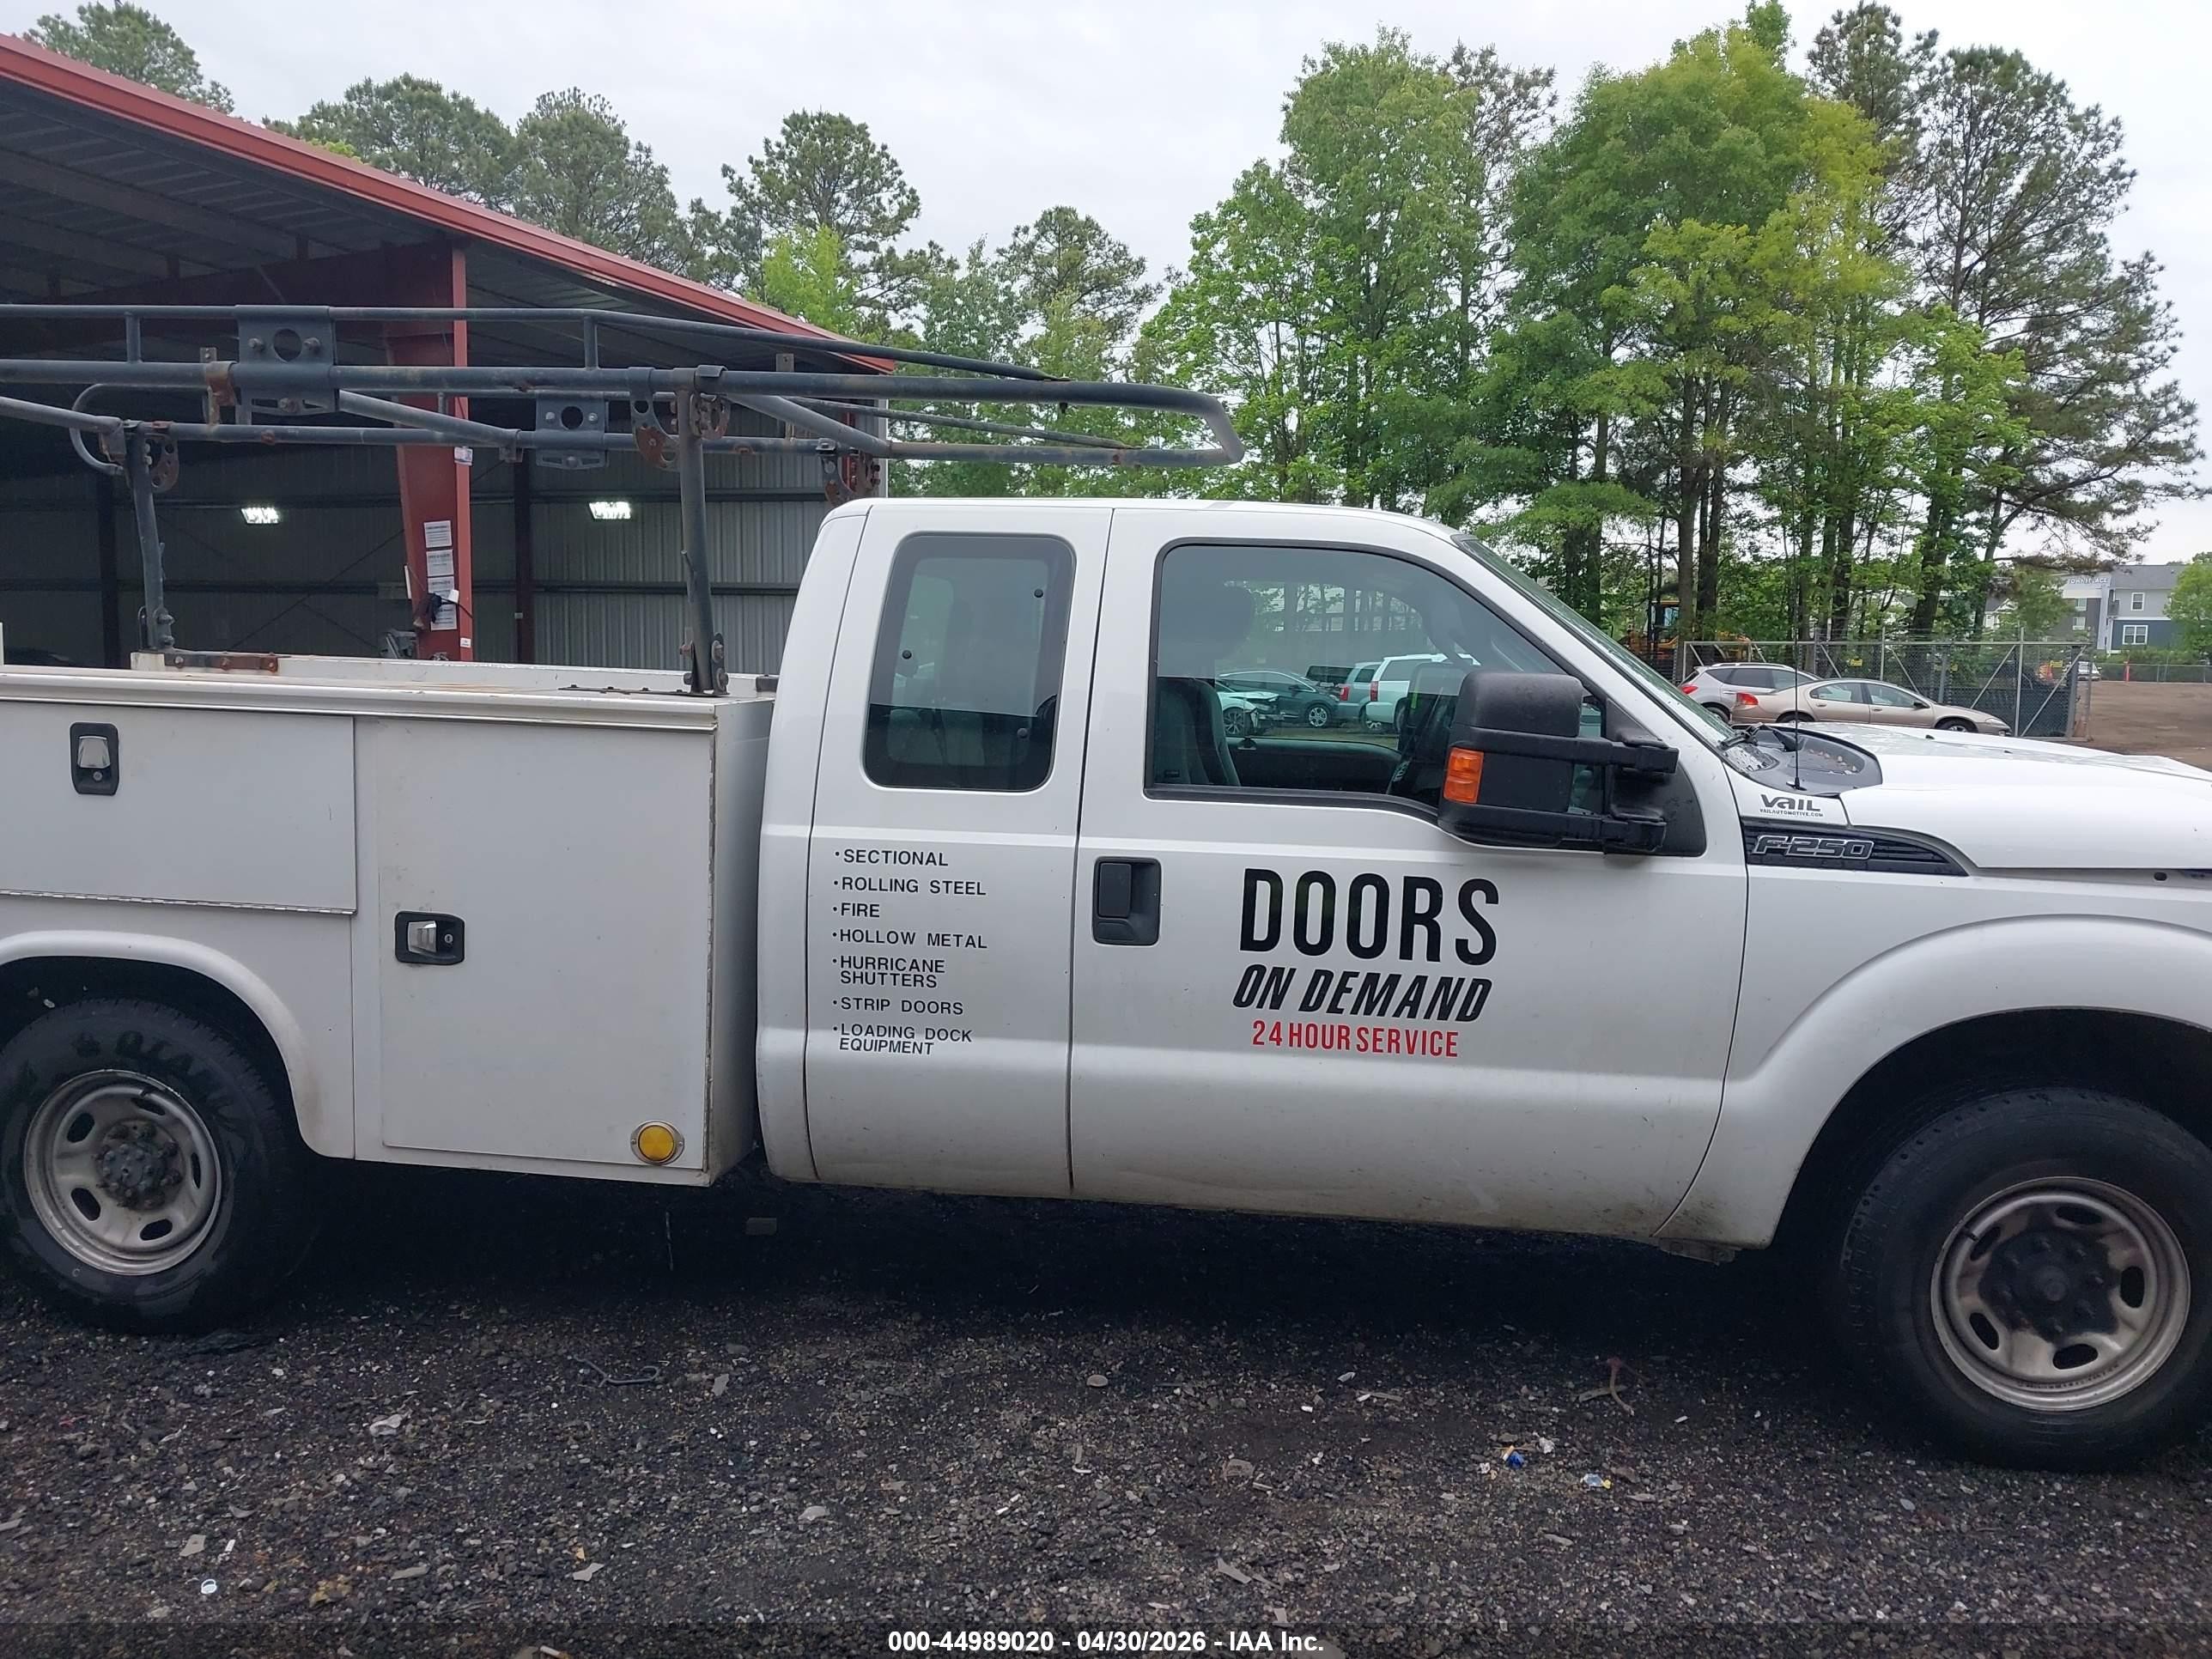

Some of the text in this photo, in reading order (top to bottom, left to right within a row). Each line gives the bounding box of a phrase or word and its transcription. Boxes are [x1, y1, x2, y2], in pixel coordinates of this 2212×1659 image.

[843, 848, 949, 866] SECTIONAL
[1752, 835, 1875, 860] F-250
[842, 876, 987, 896] ROLLING STEEL
[841, 902, 880, 918] FIRE
[1239, 867, 1500, 966] DOORS
[840, 928, 988, 949] HOLLOW METAL
[840, 954, 945, 974] HURRICANE
[840, 970, 938, 988] SHUTTERS
[1232, 963, 1493, 1023] ON DEMAND
[841, 996, 963, 1015] STRIP DOORS
[841, 1023, 973, 1042] LOADING DOCK
[1252, 1019, 1459, 1058] 24 HOUR SERVICE
[839, 1037, 934, 1055] EQUIPMENT
